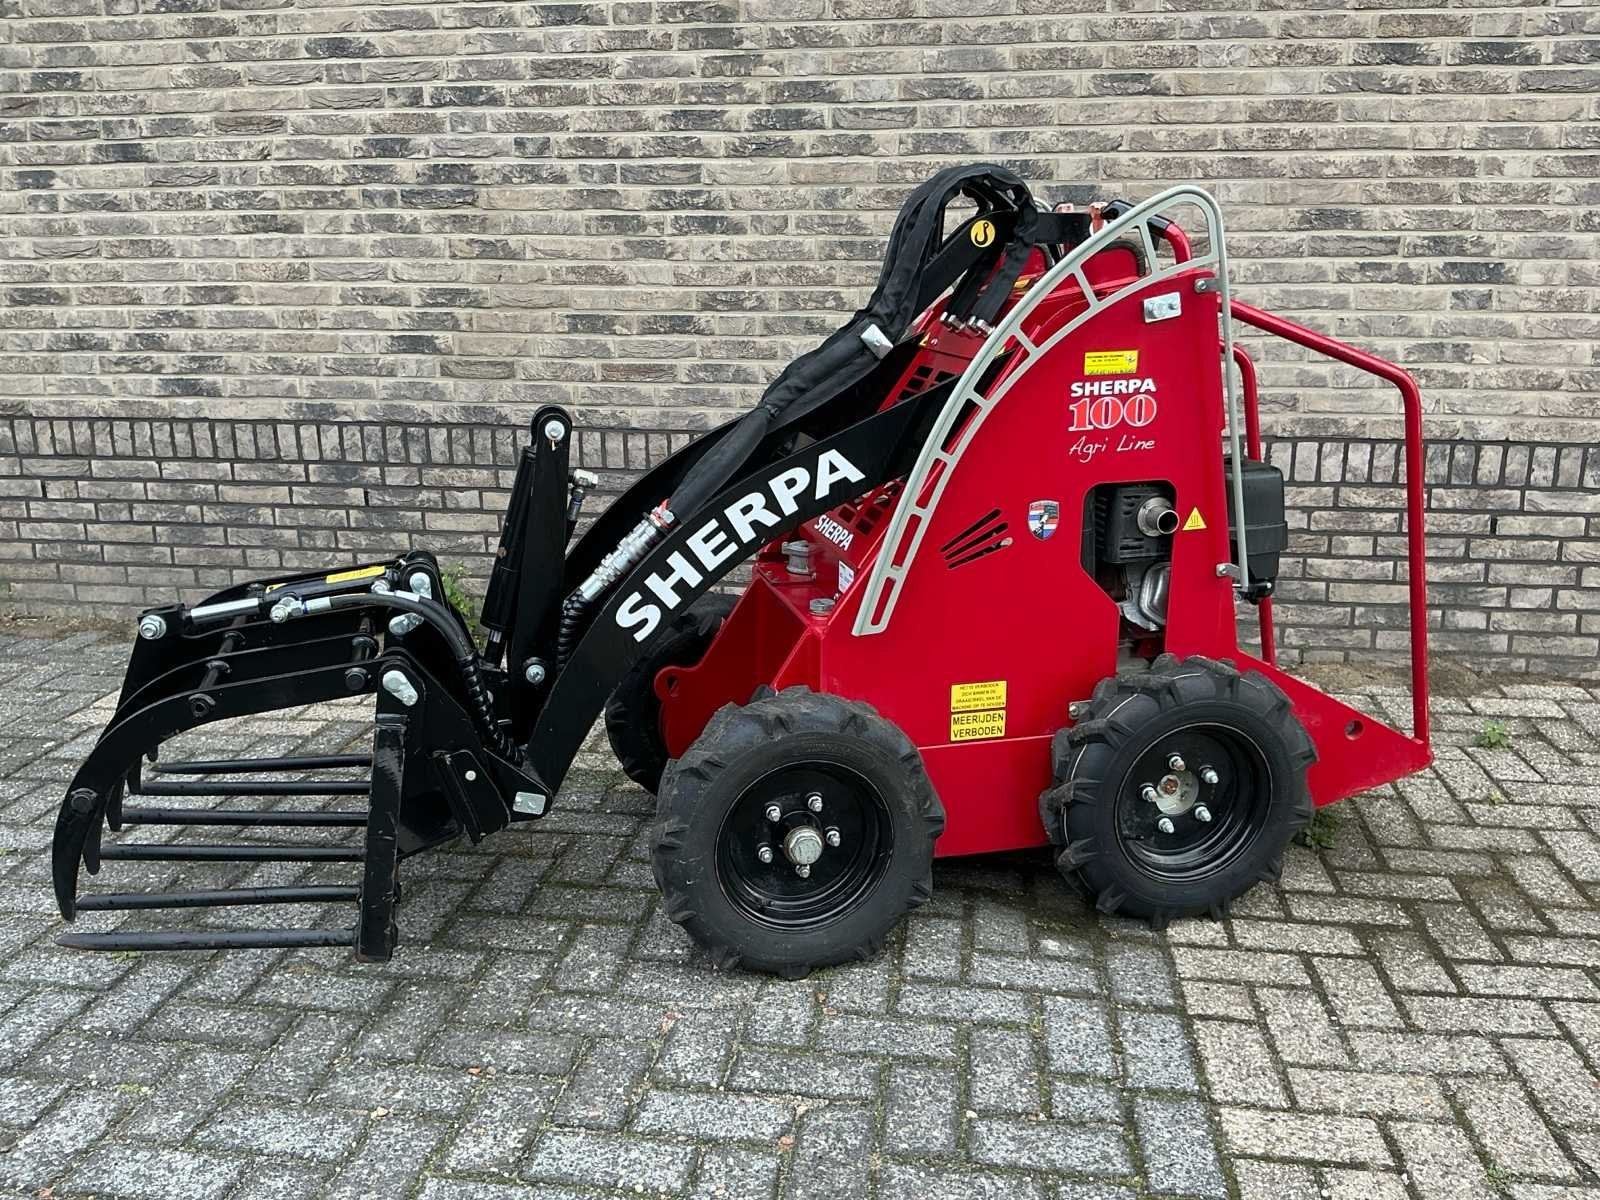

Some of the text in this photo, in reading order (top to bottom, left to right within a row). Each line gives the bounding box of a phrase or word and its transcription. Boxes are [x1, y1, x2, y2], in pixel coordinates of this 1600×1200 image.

[1070, 378, 1157, 397] SHERPA
[1068, 394, 1157, 431] 100
[1069, 434, 1156, 463] Agri Line
[615, 449, 866, 643] SHERPA
[814, 514, 854, 551] SHERPA
[952, 712, 1004, 726] MEERIJDEN
[953, 725, 1003, 738] VERBODEN
